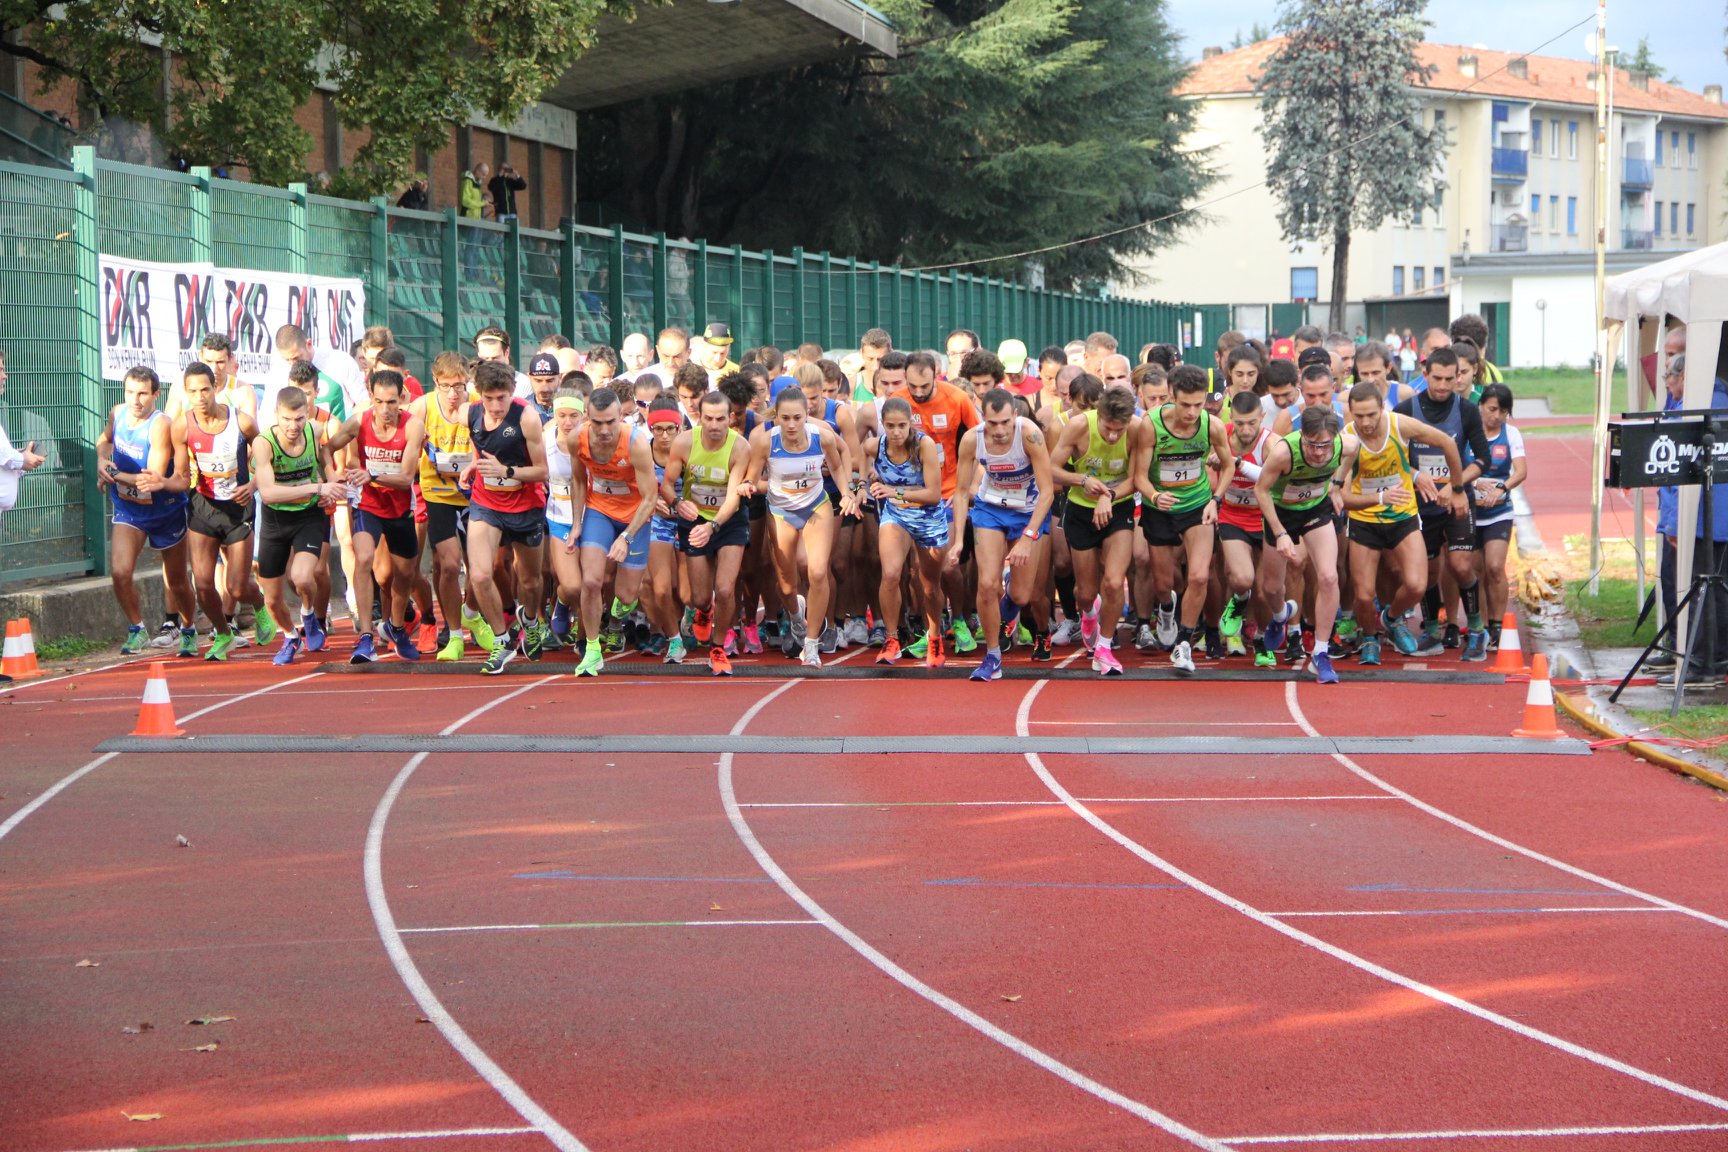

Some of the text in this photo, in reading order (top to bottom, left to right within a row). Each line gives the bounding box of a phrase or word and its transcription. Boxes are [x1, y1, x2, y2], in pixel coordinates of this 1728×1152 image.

[211, 462, 225, 472] 23
[452, 462, 459, 472] 9
[1429, 466, 1449, 477] 119
[1644, 460, 1680, 475] OTC
[1174, 470, 1188, 480] 91
[795, 480, 808, 489] 14
[126, 487, 139, 498] 24
[606, 486, 613, 494] 4
[1298, 490, 1312, 499] 90
[704, 496, 717, 506] 10
[1001, 498, 1008, 508] 5
[1236, 495, 1250, 505] 76
